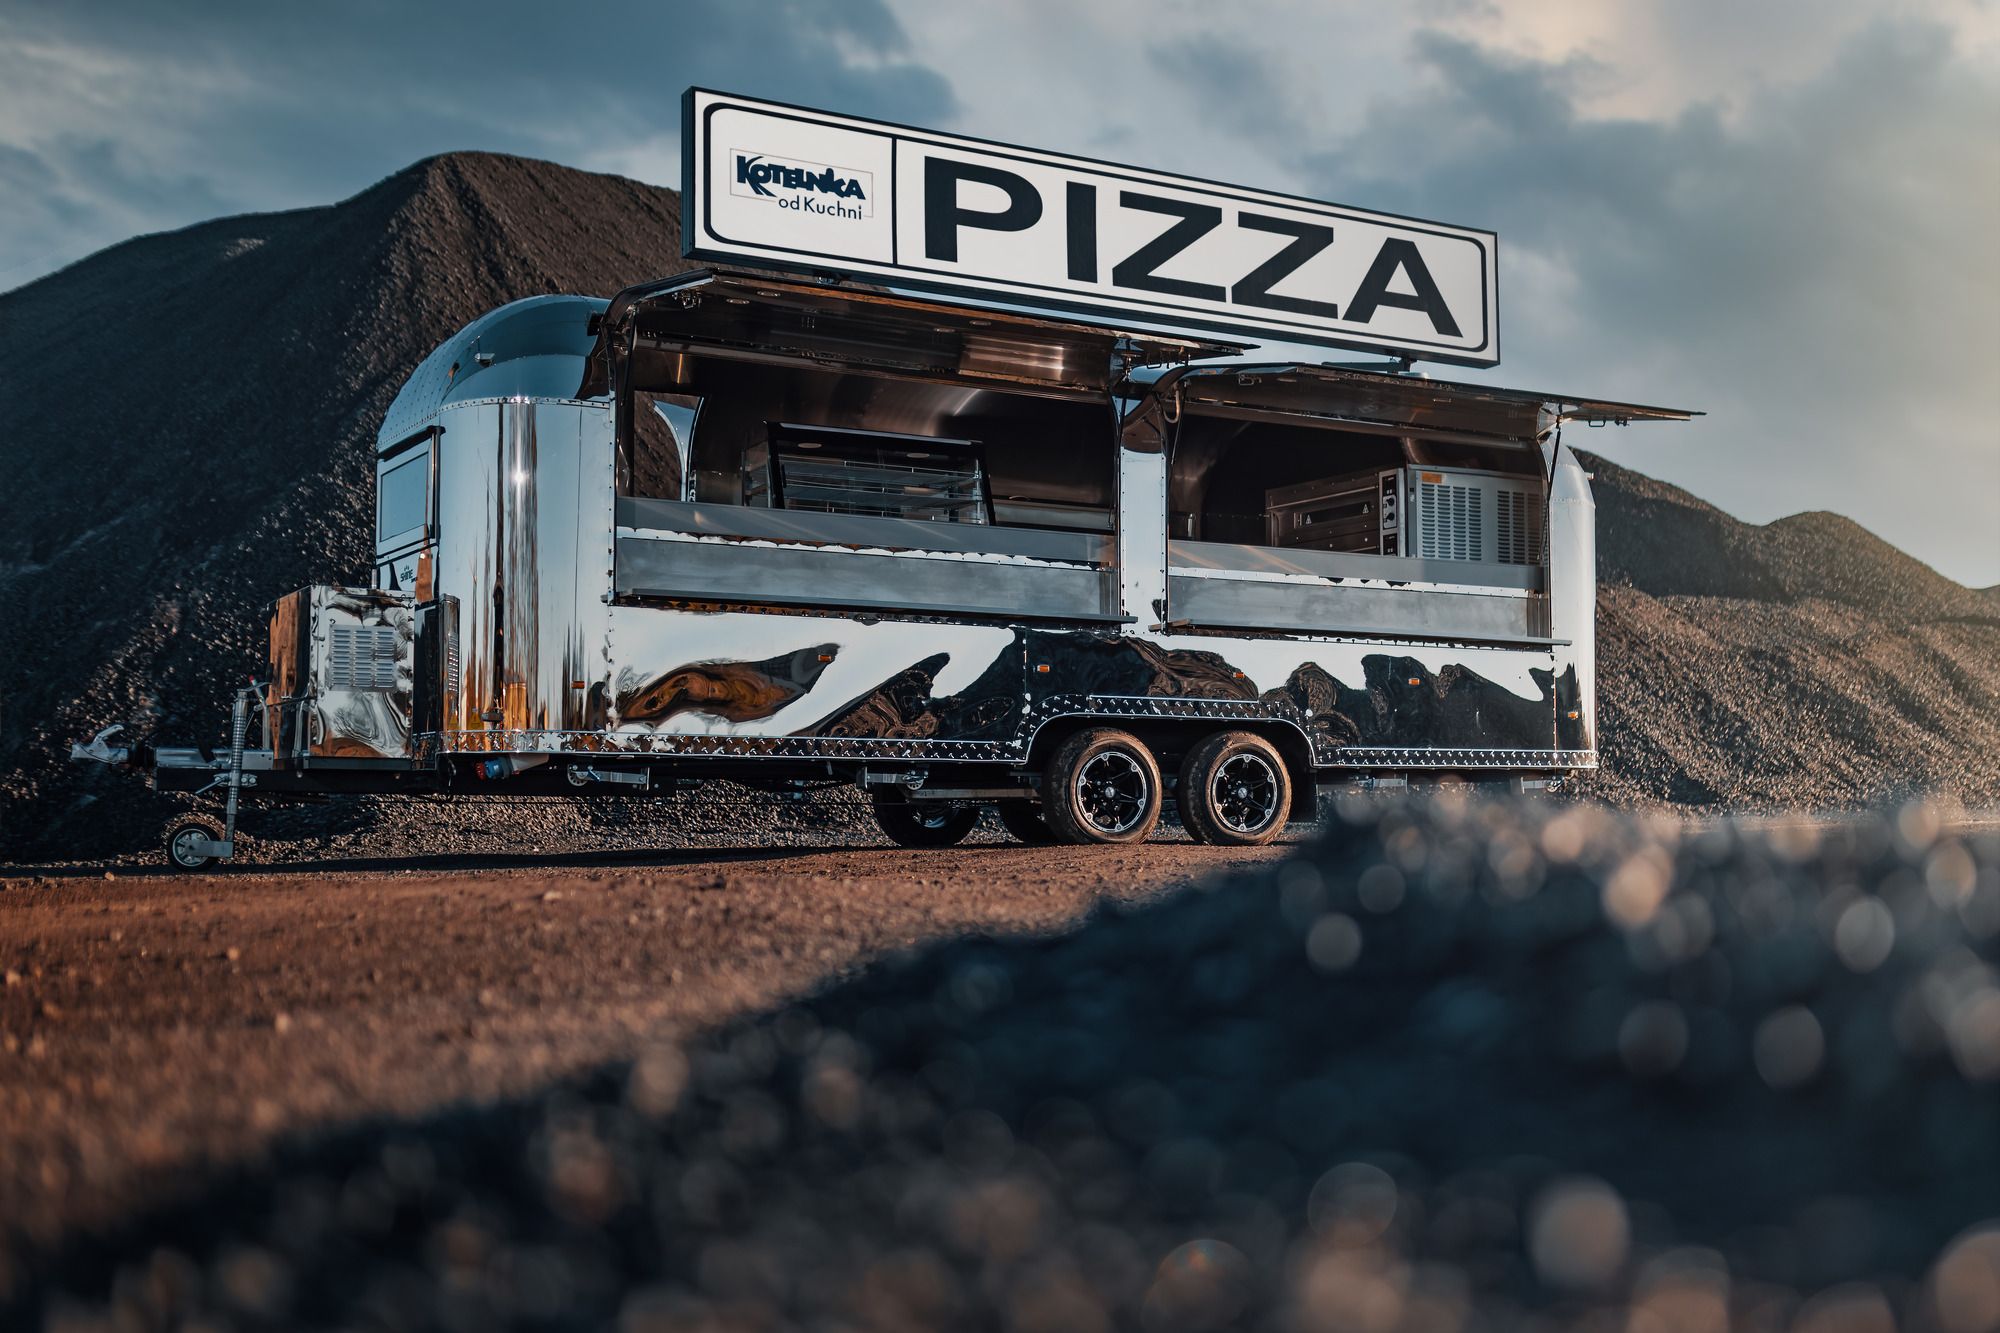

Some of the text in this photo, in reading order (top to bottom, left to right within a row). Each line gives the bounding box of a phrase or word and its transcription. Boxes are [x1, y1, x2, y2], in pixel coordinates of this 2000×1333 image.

[779, 195, 862, 220] od Kuchni
[924, 155, 1464, 338] PIZZA
